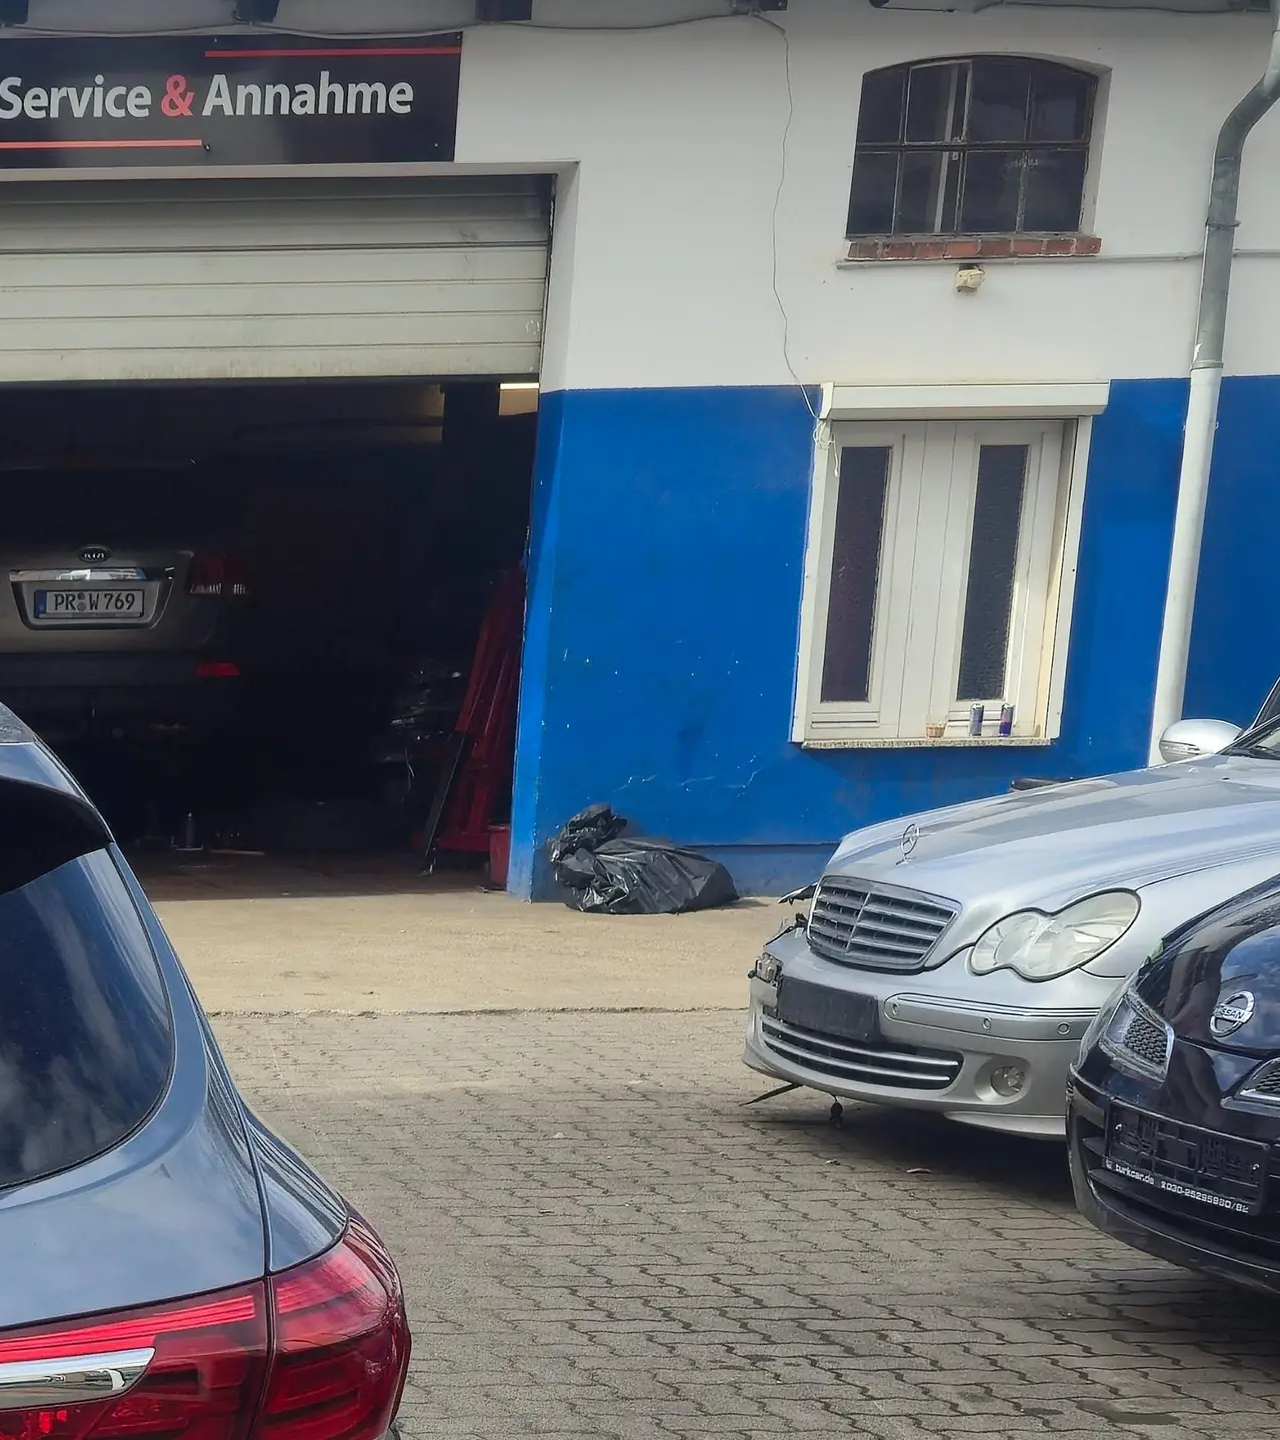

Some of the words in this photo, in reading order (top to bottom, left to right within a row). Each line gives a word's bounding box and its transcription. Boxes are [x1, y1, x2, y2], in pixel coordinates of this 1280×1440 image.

[160, 74, 194, 117] &
[202, 70, 414, 117] Annahme
[54, 592, 77, 611] PR
[88, 592, 101, 611] W
[103, 592, 136, 611] 769
